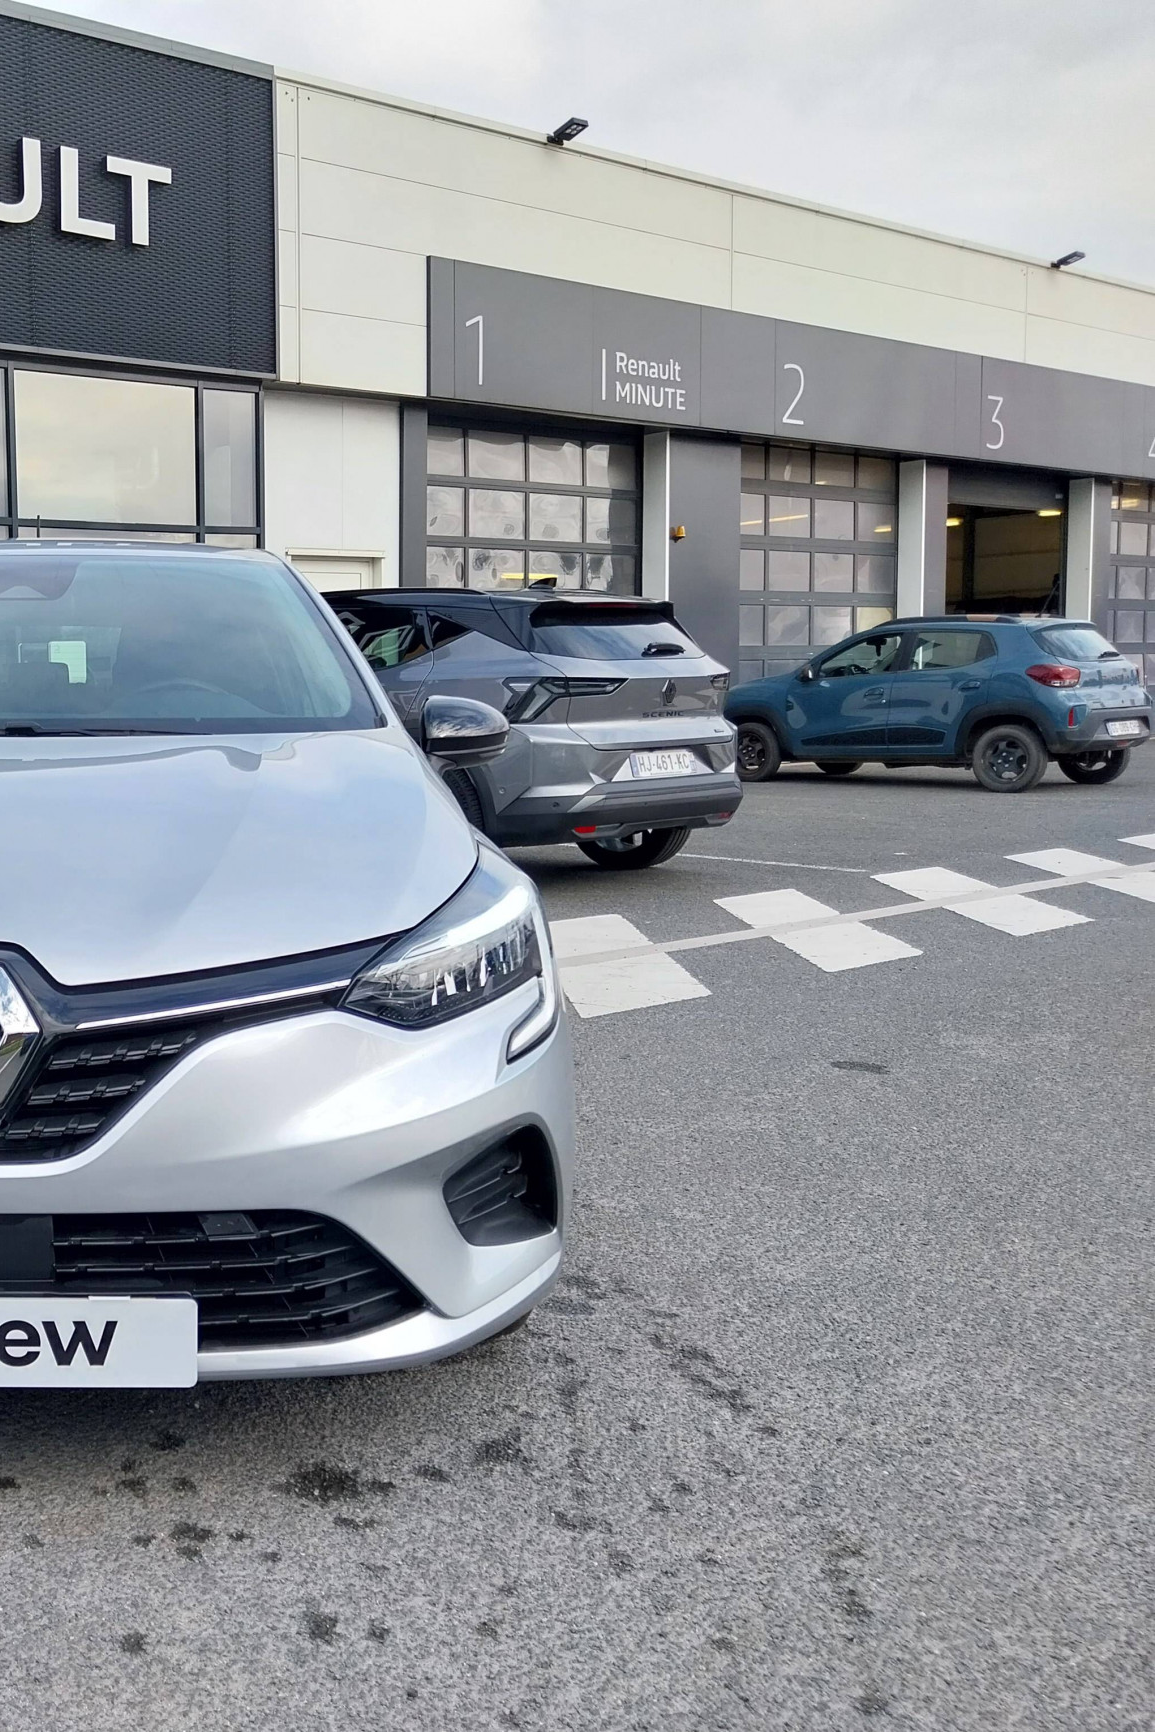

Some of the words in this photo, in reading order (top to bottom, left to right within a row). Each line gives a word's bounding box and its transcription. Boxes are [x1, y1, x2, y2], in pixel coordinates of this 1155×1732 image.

[465, 315, 484, 386] 1
[615, 351, 682, 382] Renault
[615, 381, 687, 411] MINUTE
[781, 363, 805, 426] 2
[985, 394, 1005, 450] 3
[642, 710, 684, 718] SCENIC
